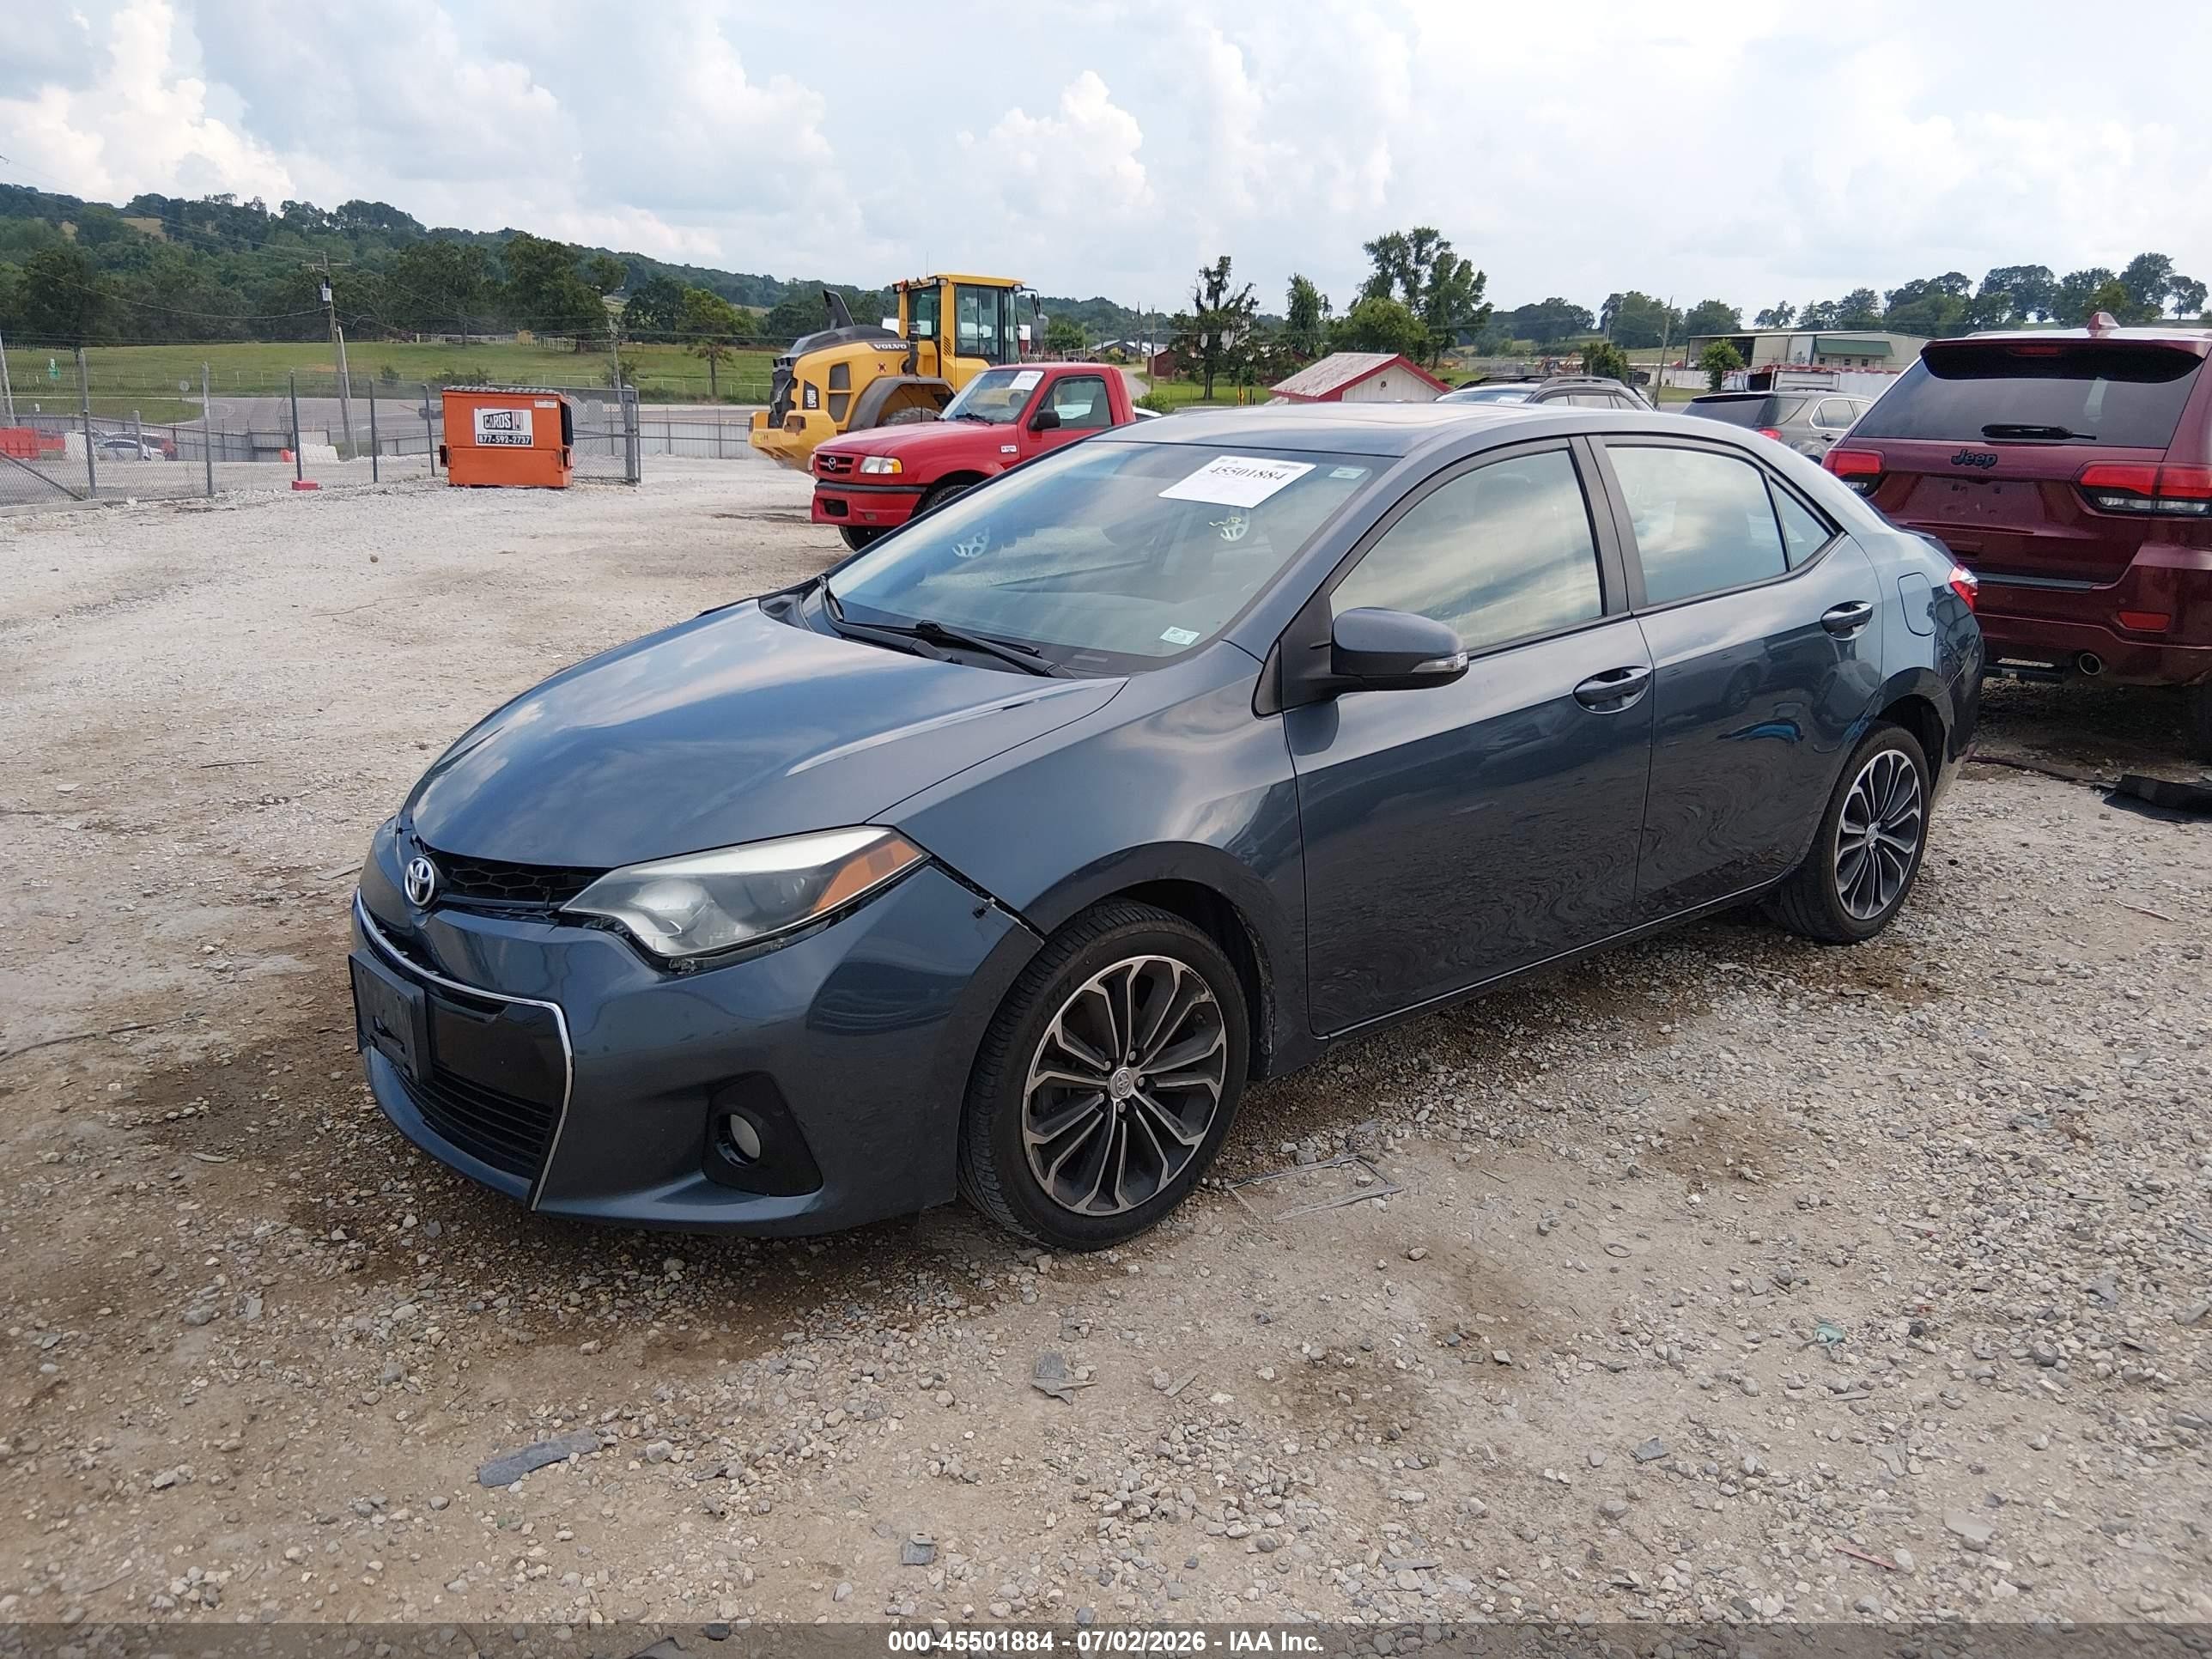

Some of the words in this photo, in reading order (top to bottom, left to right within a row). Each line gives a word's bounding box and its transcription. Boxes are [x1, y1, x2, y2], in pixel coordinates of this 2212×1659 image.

[806, 389, 817, 408] L90H
[484, 413, 511, 428] CARDS
[478, 434, 531, 444] 877-592-2737
[1950, 448, 1998, 470] Jeep
[1208, 465, 1289, 481] 45501884
